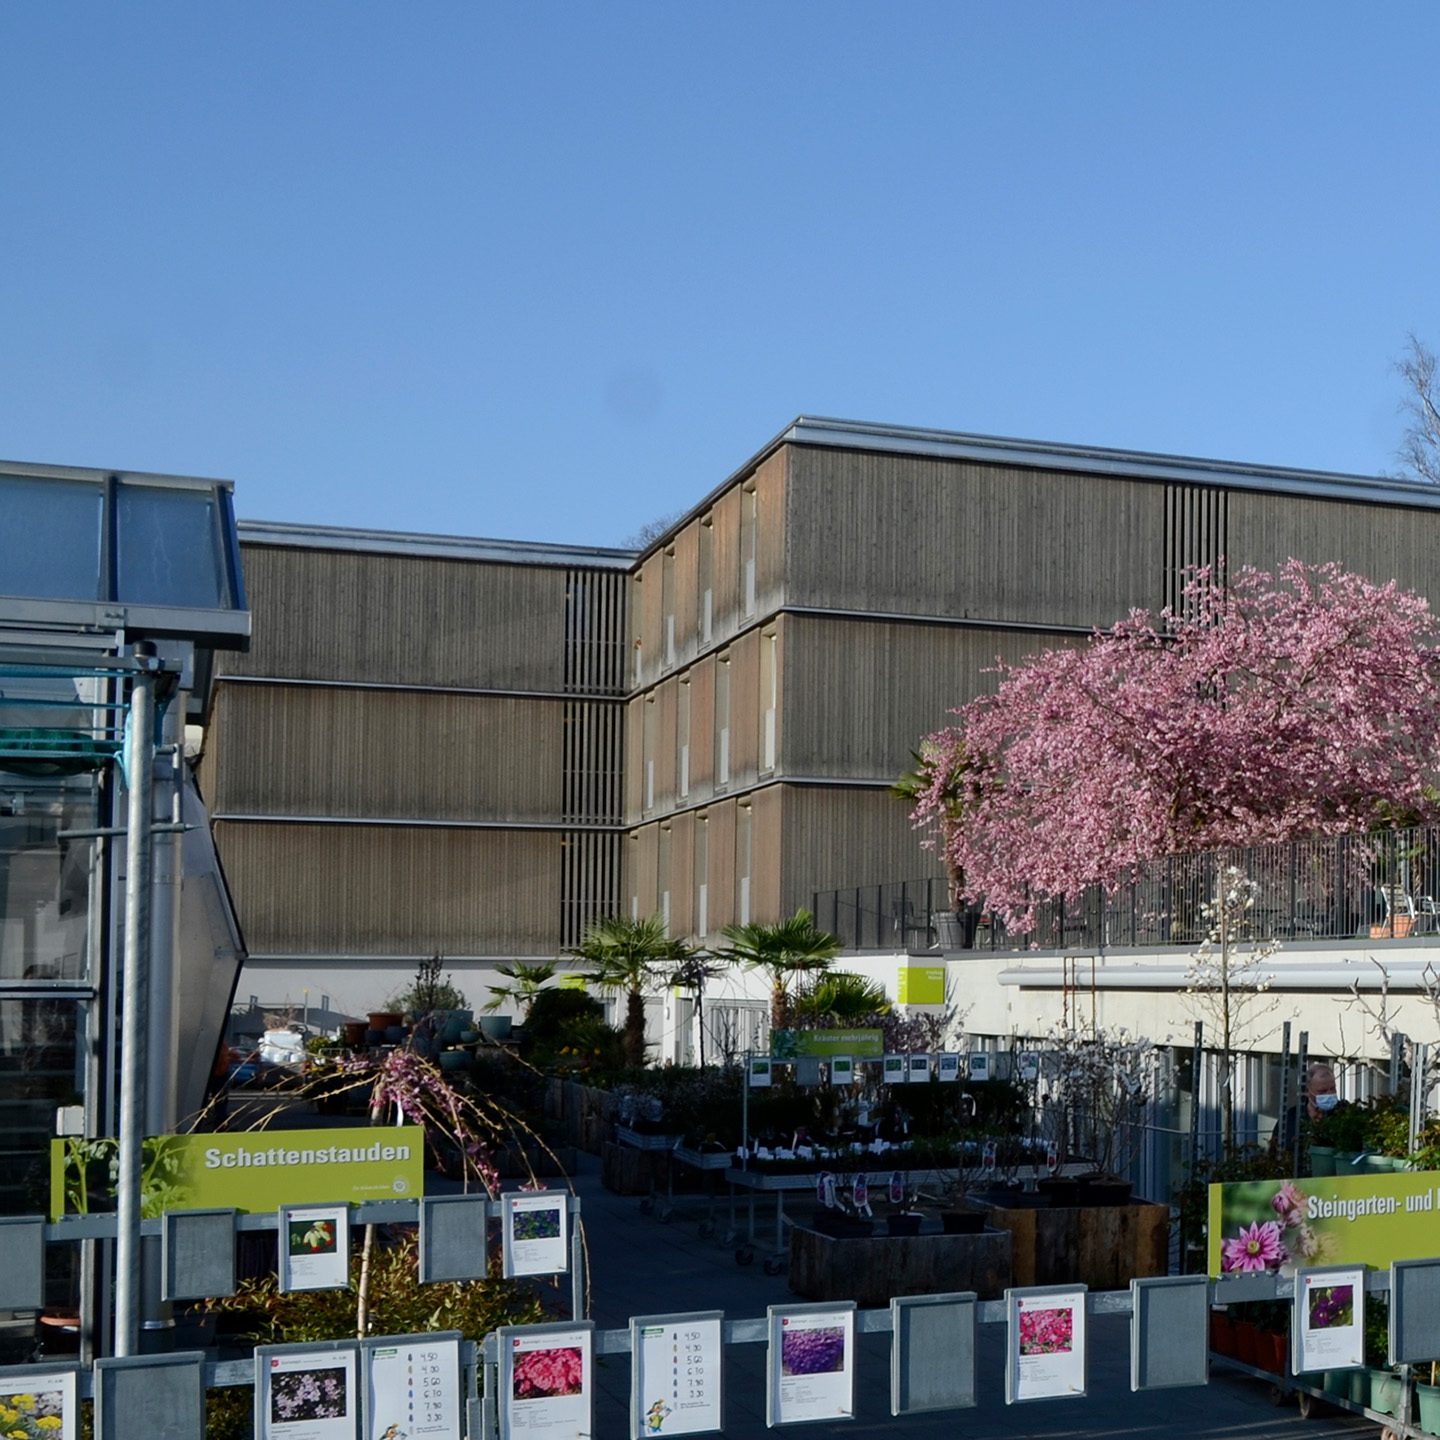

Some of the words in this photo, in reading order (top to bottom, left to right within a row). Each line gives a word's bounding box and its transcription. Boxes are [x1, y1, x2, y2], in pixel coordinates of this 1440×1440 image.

[205, 1141, 411, 1169] Schattenstauden
[1307, 1194, 1402, 1222] Steingarten-
[1405, 1188, 1433, 1212] und
